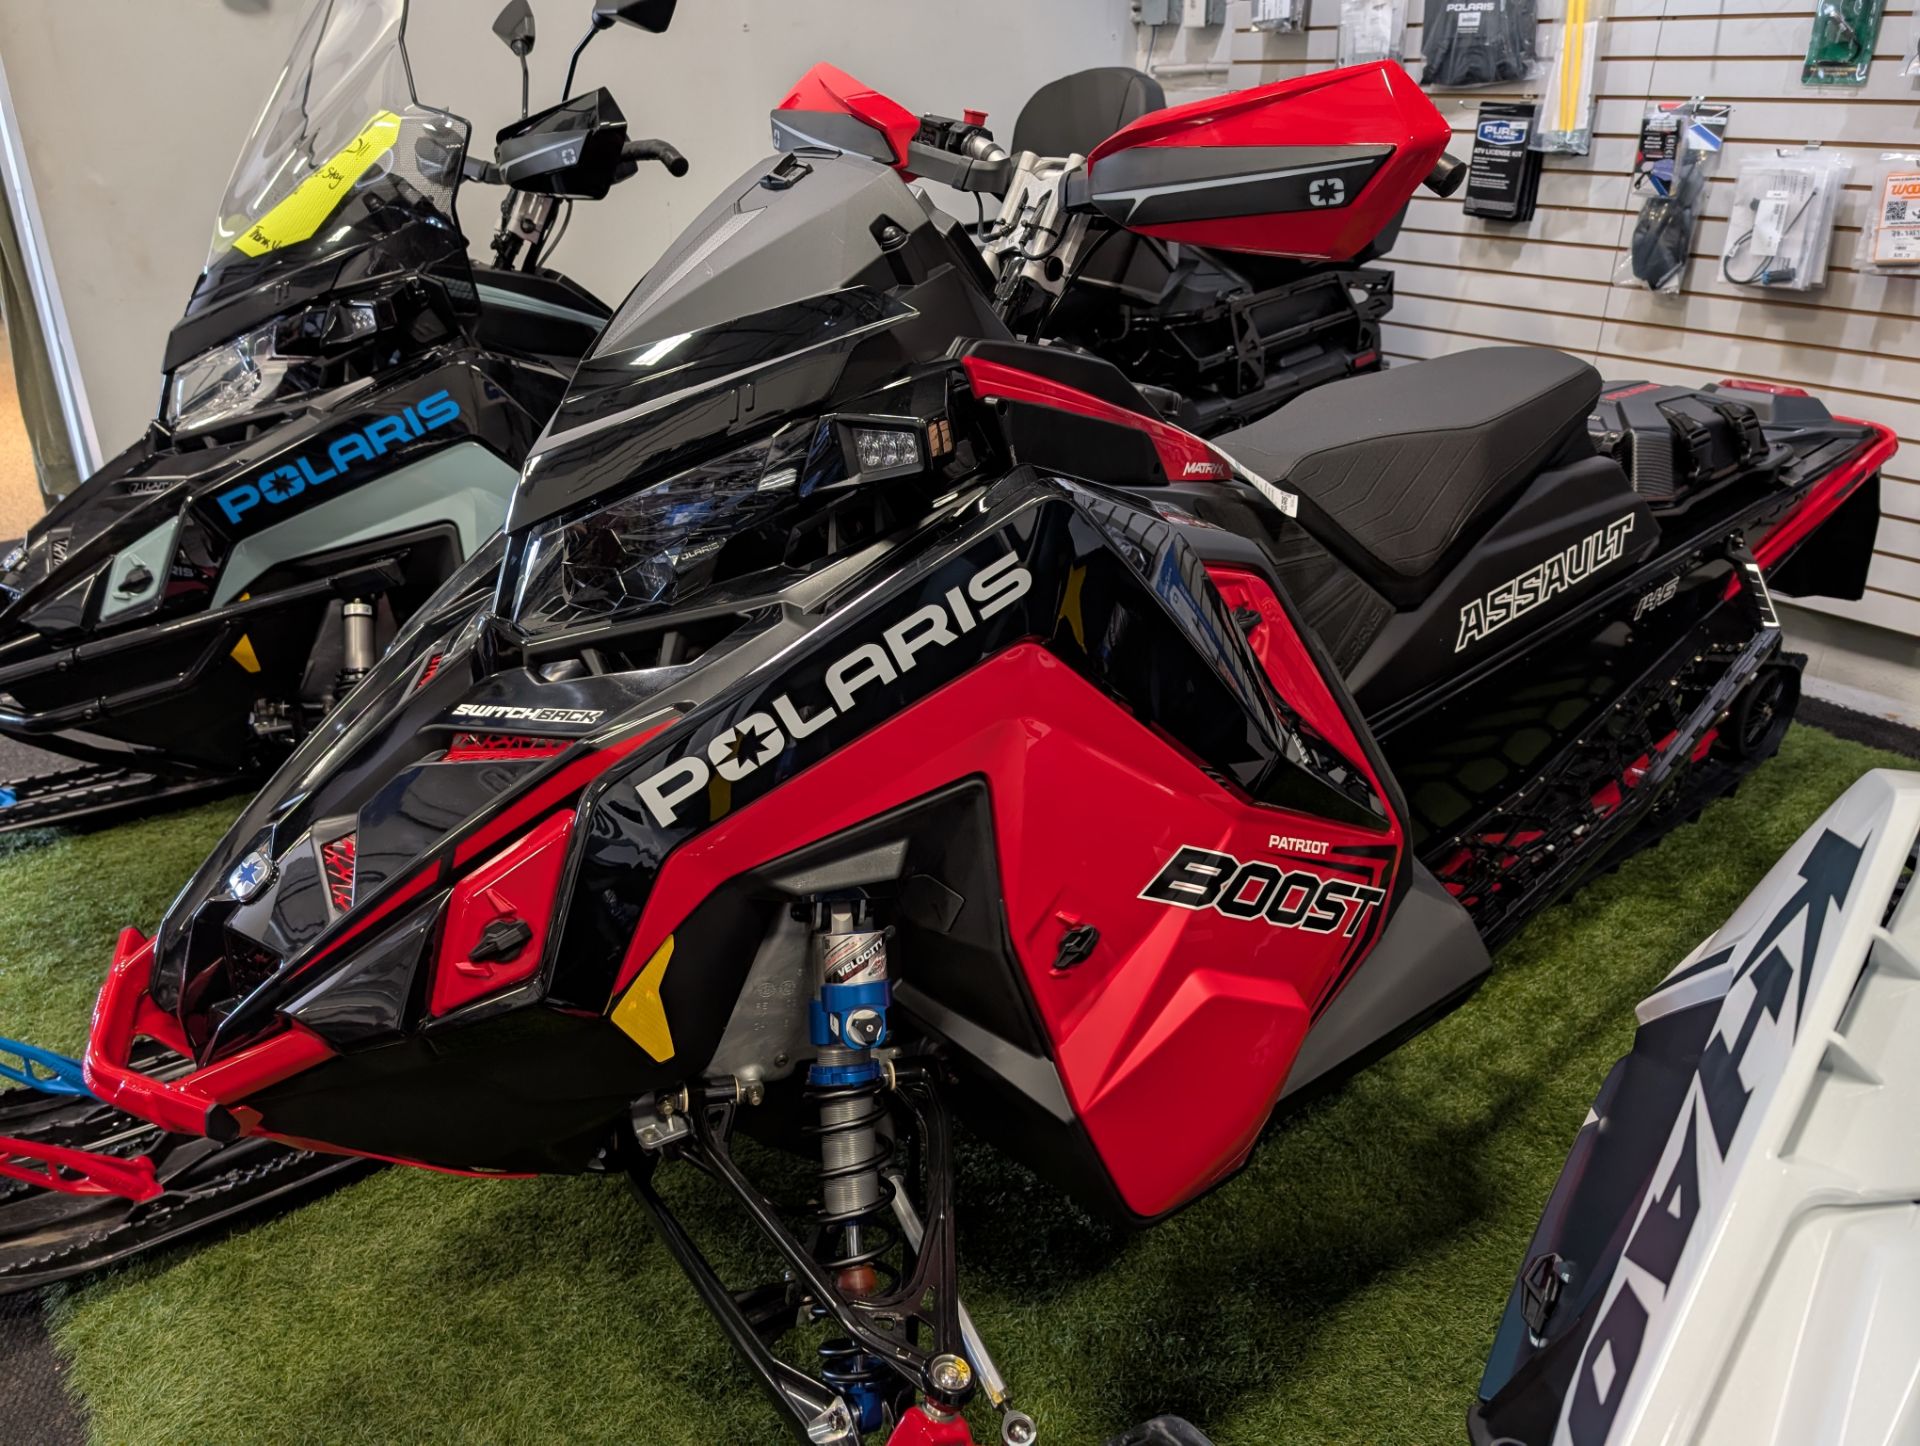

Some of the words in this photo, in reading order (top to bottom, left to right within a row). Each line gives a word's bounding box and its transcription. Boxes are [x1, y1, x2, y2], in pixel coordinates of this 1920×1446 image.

[1446, 2, 1495, 12] POLARIS
[1511, 150, 1523, 158] KIT
[216, 389, 461, 525] POLARIS
[1183, 461, 1224, 477] MATRYX
[676, 542, 720, 561] OLARIS
[1454, 512, 1635, 653] ASSAULT
[634, 551, 1032, 829] POLARIS
[452, 703, 604, 724] SWITCHBACK
[1268, 834, 1329, 855] PATRIOT
[1136, 843, 1387, 938] BOOST
[837, 937, 883, 977] VELOCITY
